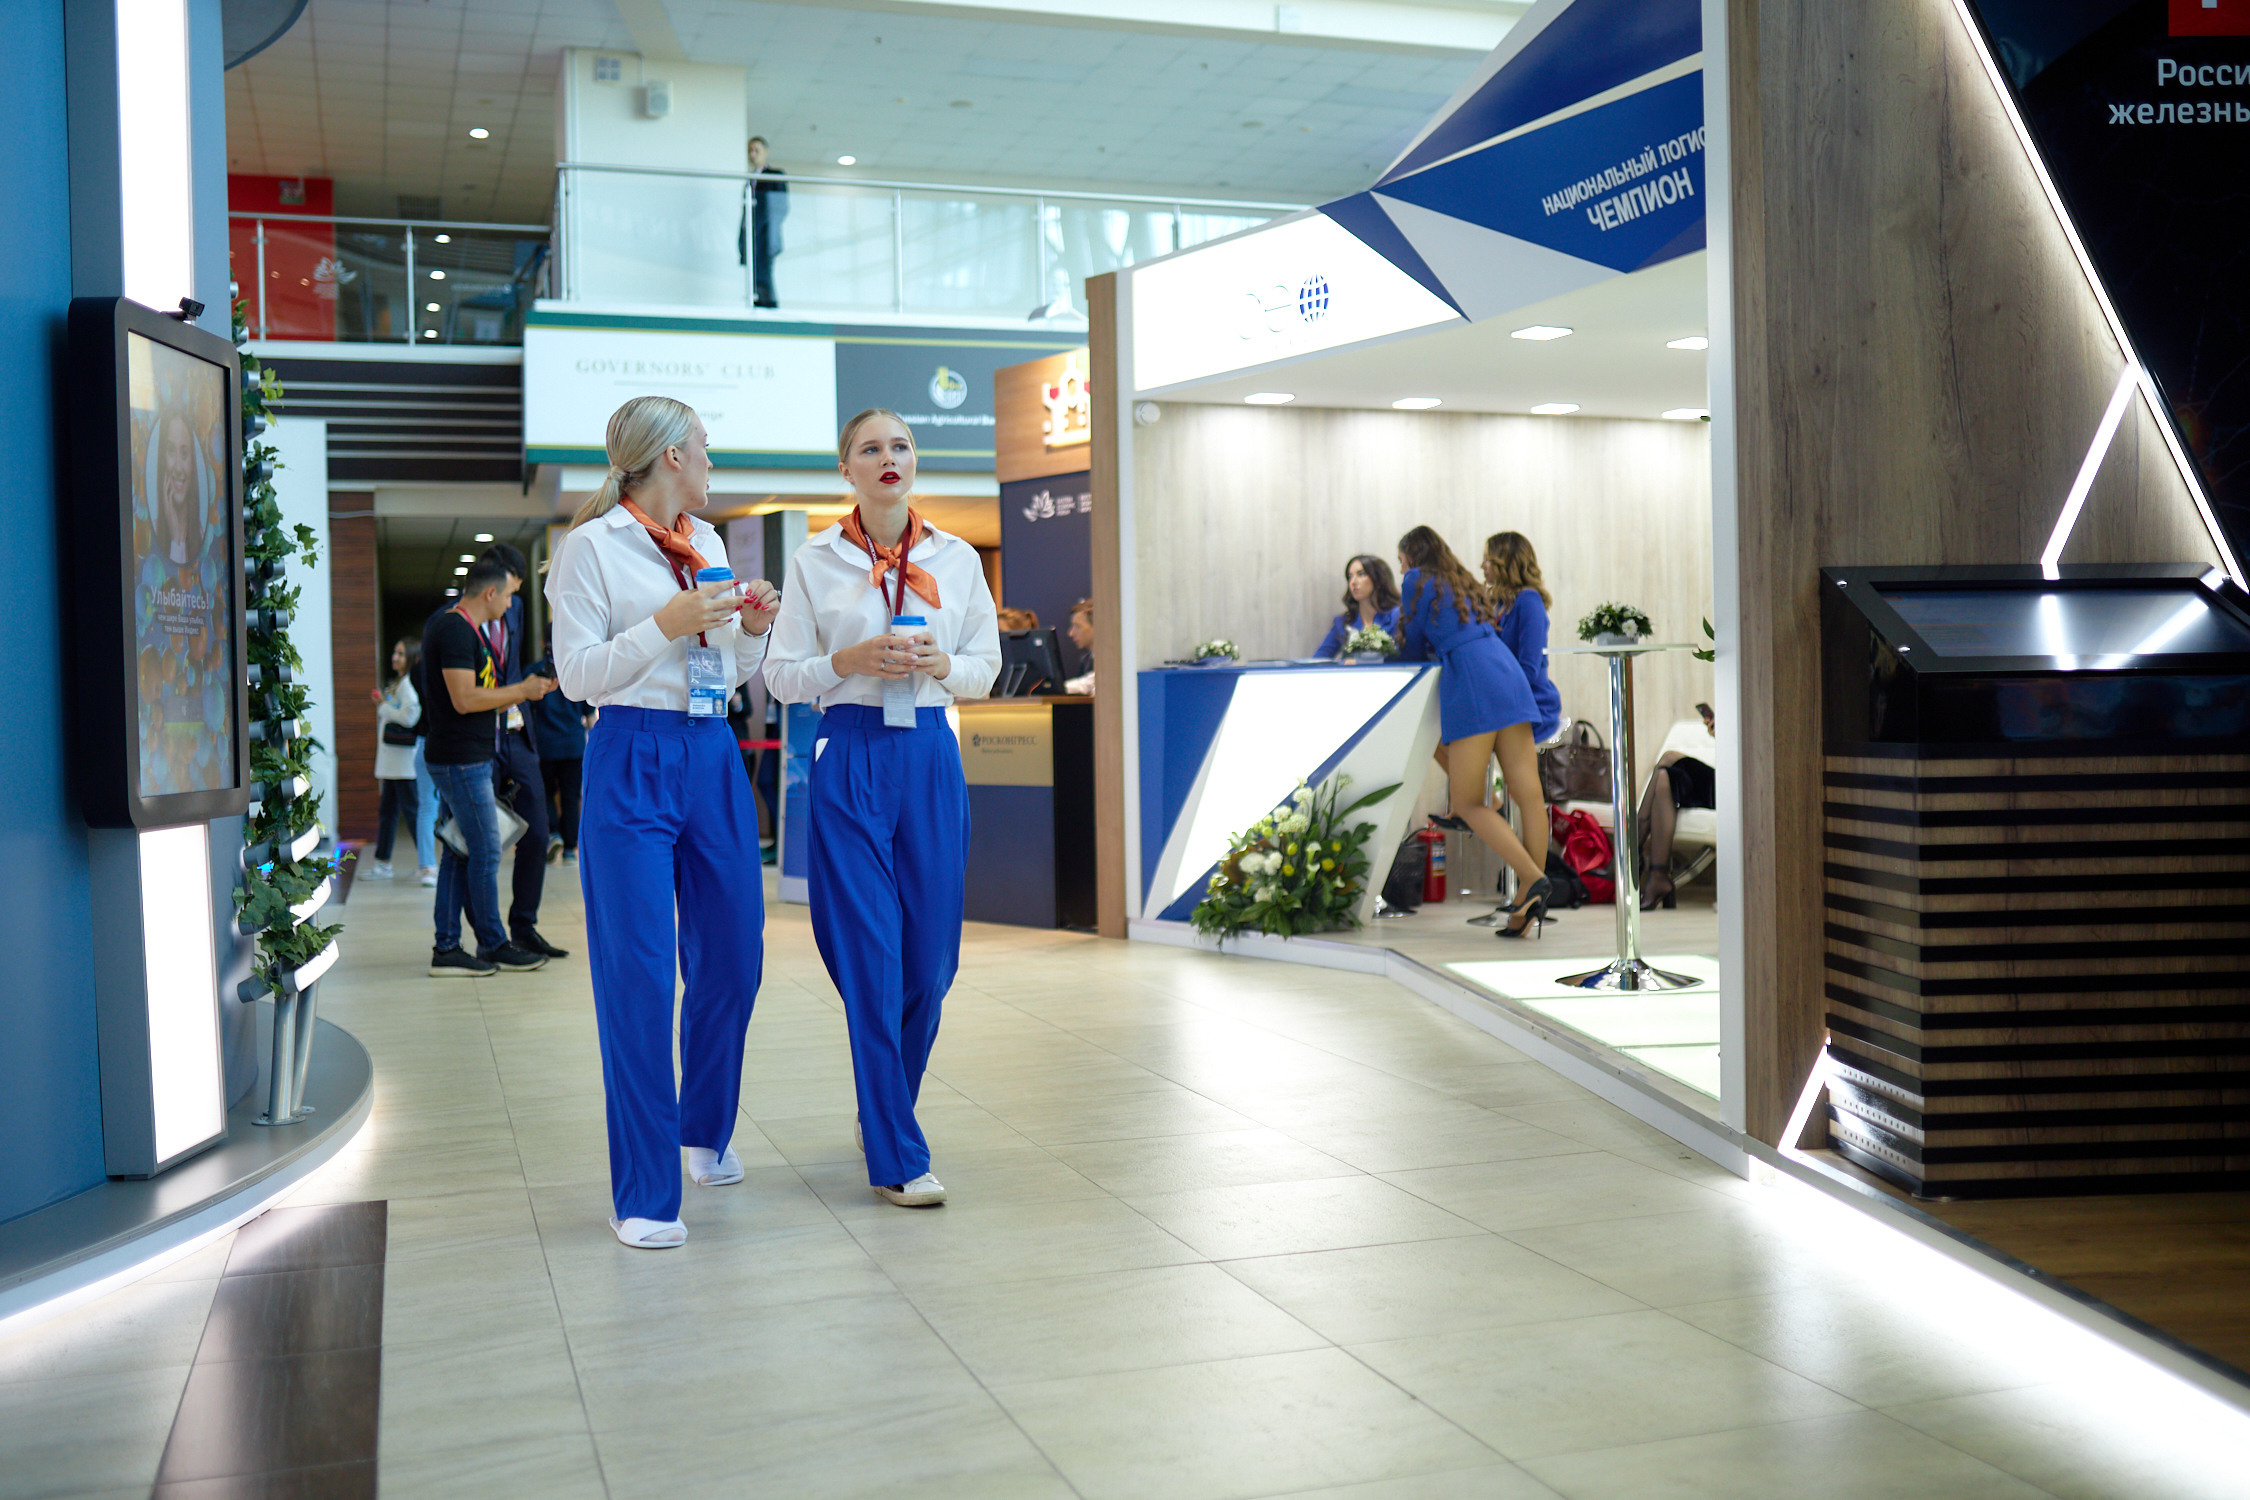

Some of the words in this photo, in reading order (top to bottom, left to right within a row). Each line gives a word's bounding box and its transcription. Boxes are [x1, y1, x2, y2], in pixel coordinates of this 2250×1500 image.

[1541, 145, 1659, 217] НАЦИОНАЛЬНЫЙ
[1586, 166, 1695, 232] ЧЕМПИОН
[721, 364, 775, 380] CLUB
[931, 412, 980, 427] Agricultural
[150, 585, 210, 610] Улыбайтесь!
